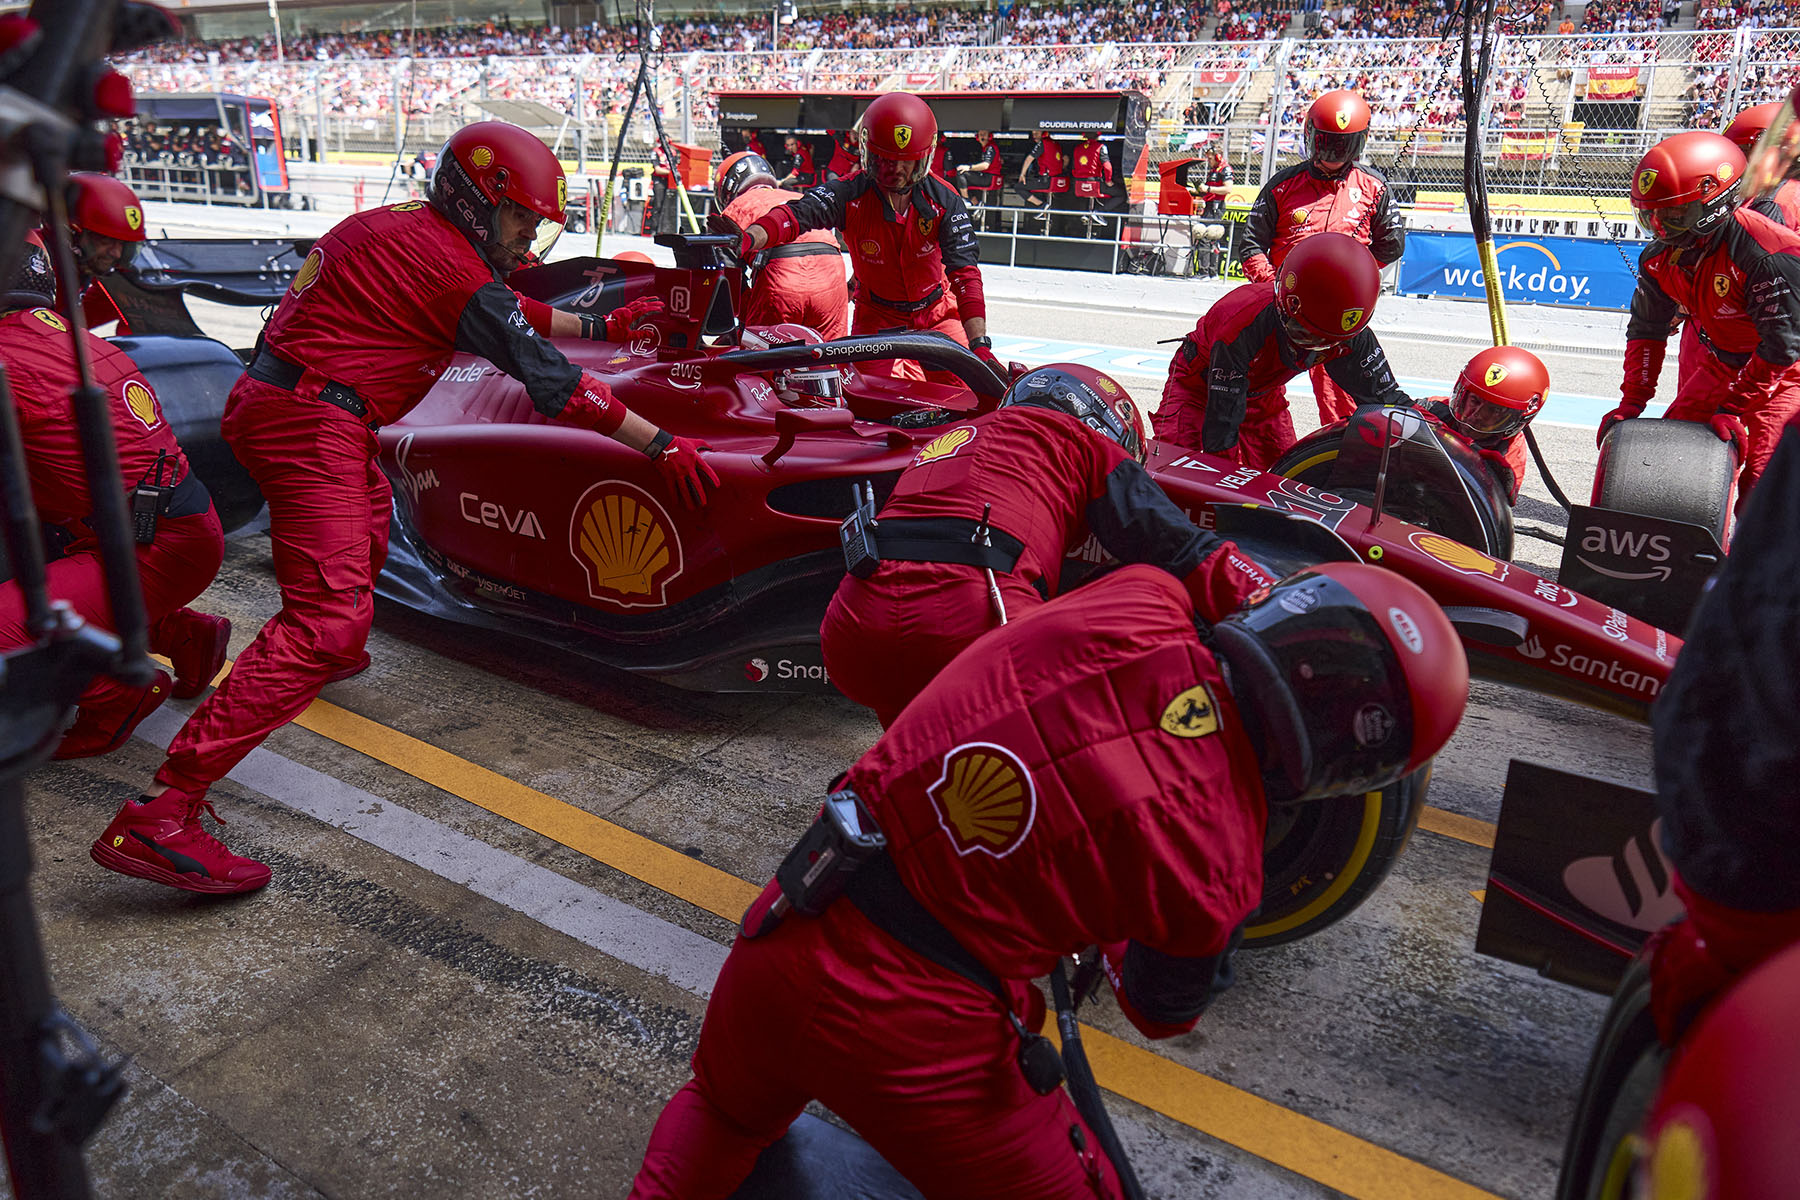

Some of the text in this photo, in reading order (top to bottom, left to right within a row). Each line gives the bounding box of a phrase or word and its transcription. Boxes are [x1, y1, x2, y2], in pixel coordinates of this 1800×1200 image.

[1039, 121, 1113, 129] SCUDERIA FERRARI
[453, 161, 489, 206] RICHARD MILLE
[825, 342, 893, 356] Snapdragon
[671, 363, 702, 380] aws
[1080, 383, 1122, 430] RICHARD MILLE
[1216, 467, 1263, 490] VELAS
[1266, 478, 1358, 532] 16
[1580, 526, 1671, 562] aws
[1533, 579, 1561, 602] aws
[1394, 613, 1418, 646] BELL
[1550, 644, 1666, 697] Santan
